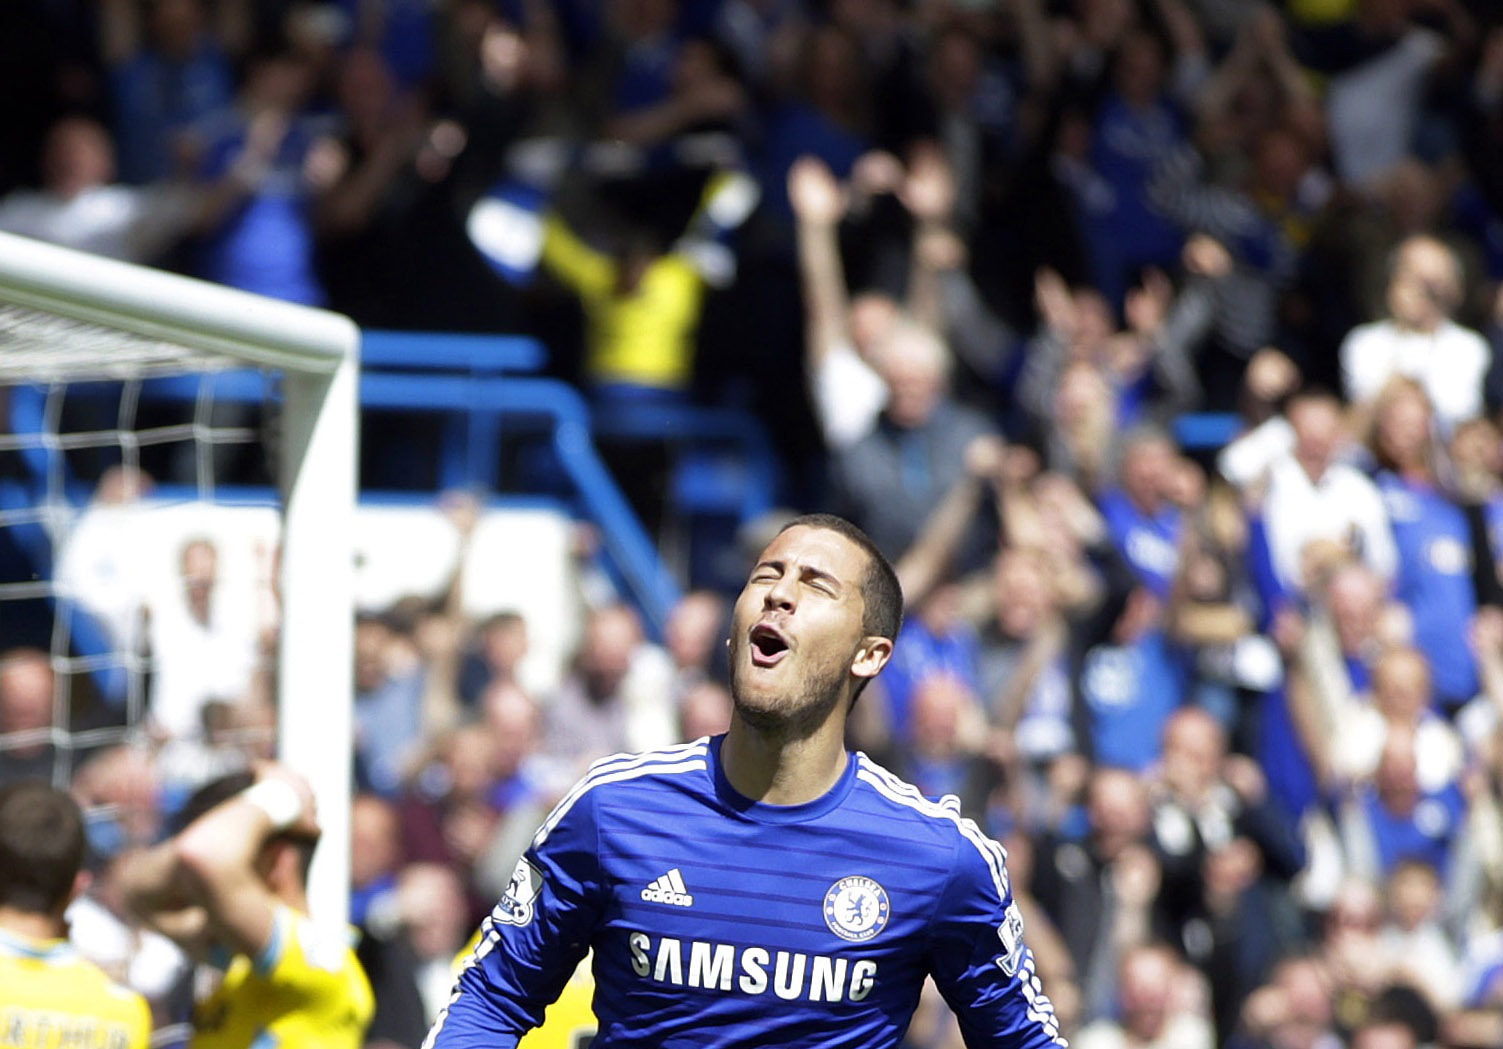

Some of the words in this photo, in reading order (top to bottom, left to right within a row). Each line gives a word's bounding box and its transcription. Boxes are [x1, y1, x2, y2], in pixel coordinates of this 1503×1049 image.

[838, 879, 881, 897] CHELSEA
[641, 889, 693, 907] adidas
[629, 931, 878, 1002] SAMSUNG
